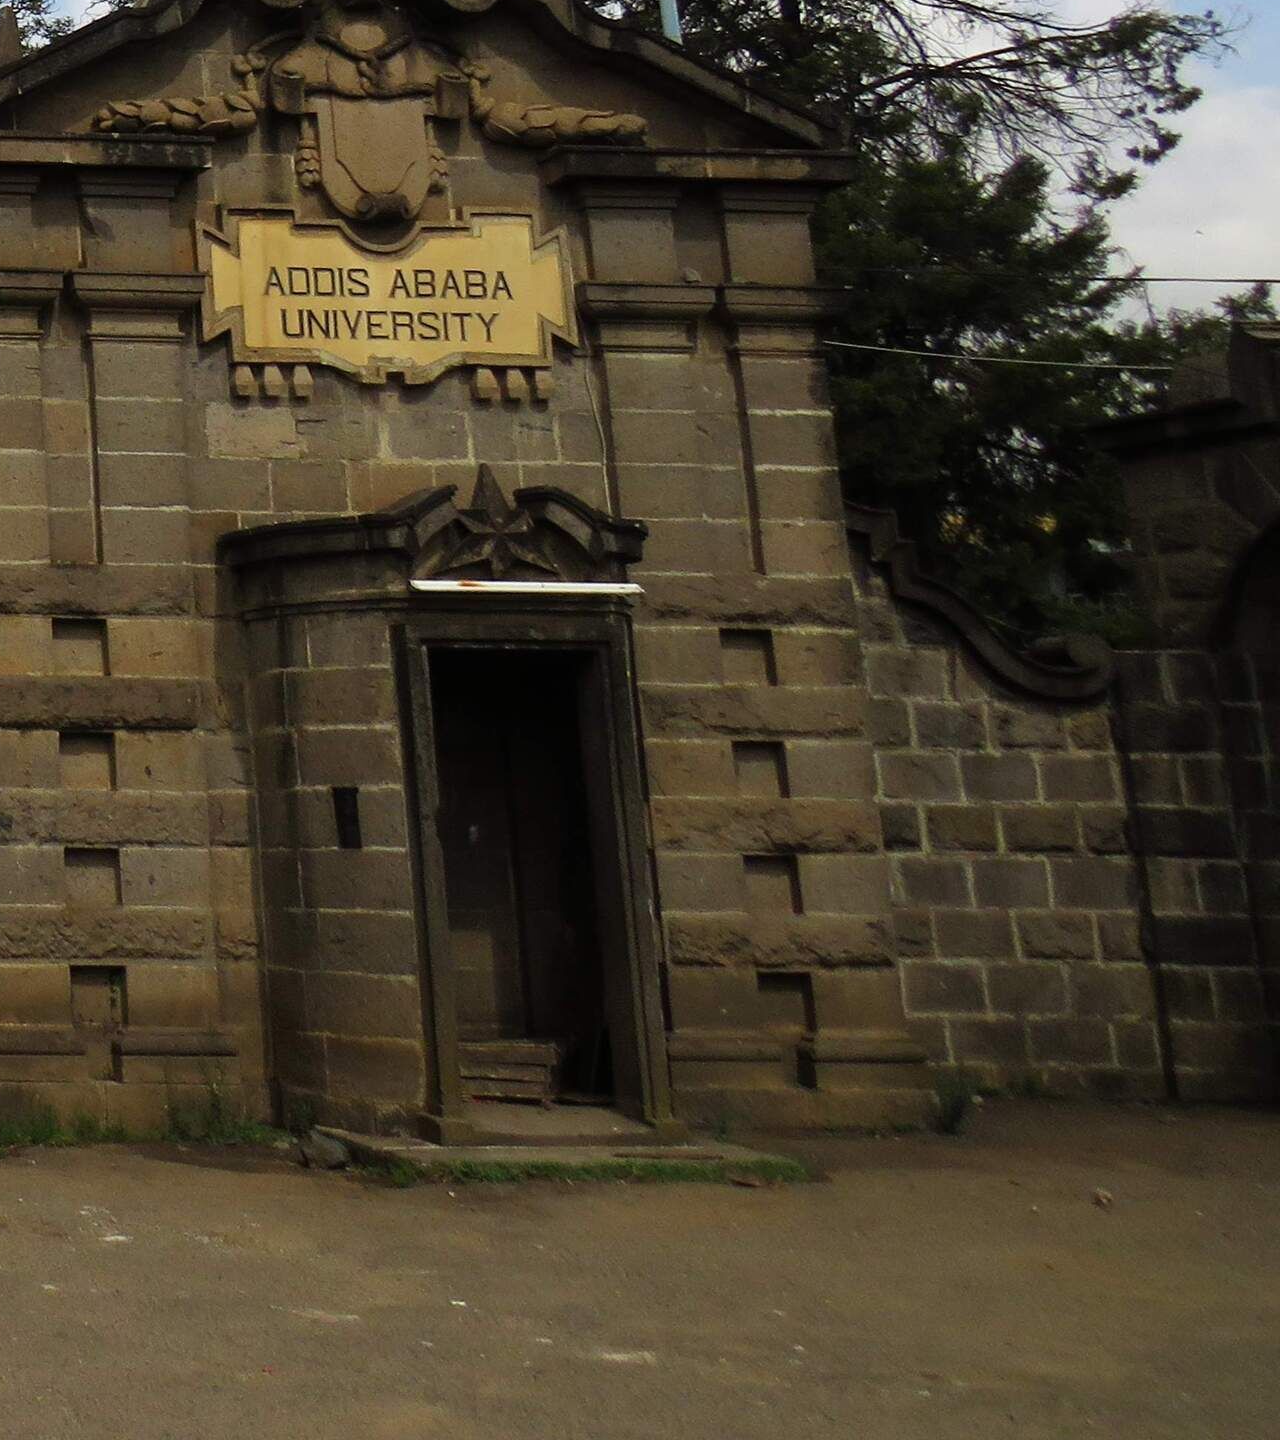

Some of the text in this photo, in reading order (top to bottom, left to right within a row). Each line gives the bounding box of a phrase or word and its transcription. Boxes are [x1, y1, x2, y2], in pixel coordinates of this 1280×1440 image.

[263, 265, 515, 301] ADDIS ABABA
[280, 308, 500, 344] UNIVERSITY
